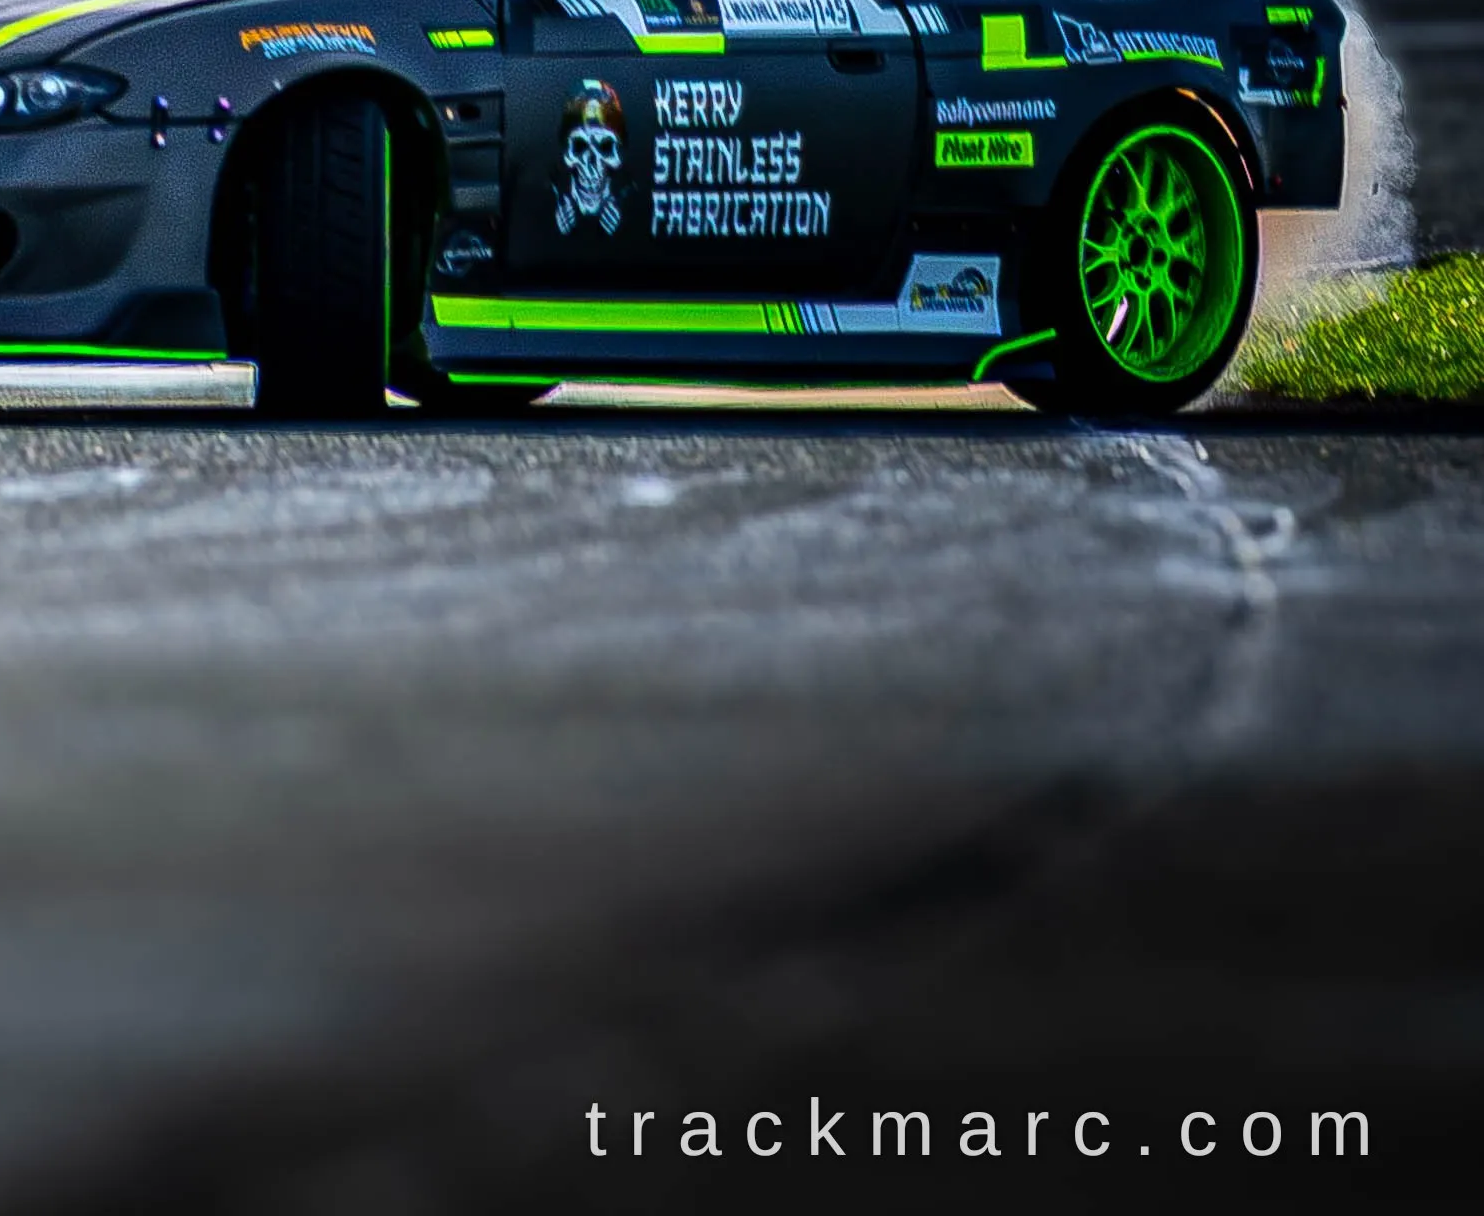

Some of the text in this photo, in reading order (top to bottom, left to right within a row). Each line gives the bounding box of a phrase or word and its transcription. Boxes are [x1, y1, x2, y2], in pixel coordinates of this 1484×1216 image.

[654, 79, 744, 127] KERRY
[653, 130, 802, 185] STAINLESS
[651, 190, 831, 237] FABRICATION
